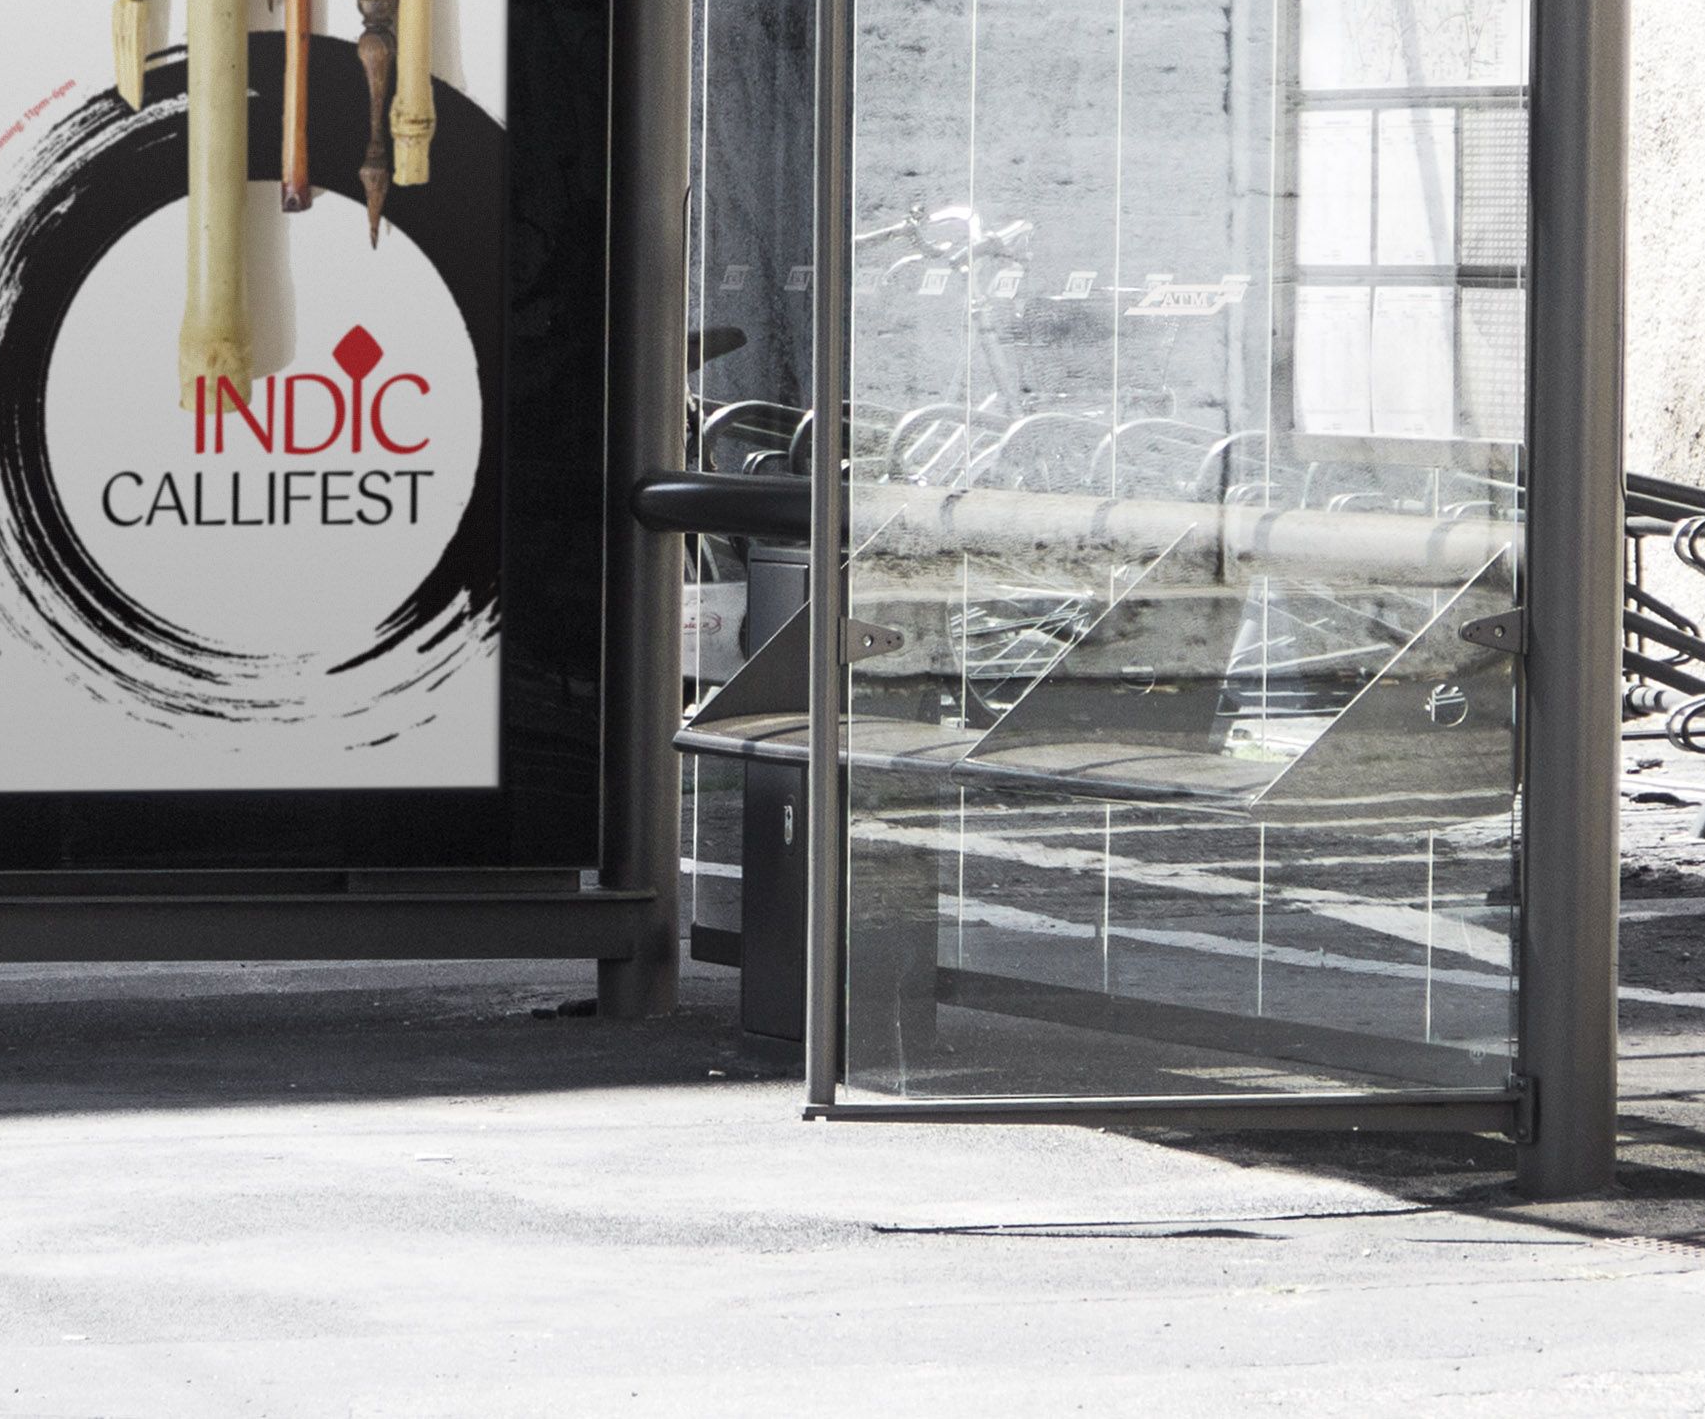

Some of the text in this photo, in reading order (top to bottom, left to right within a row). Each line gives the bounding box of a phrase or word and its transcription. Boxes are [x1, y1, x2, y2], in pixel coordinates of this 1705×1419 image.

[1160, 292, 1209, 307] ATM
[195, 324, 431, 455] INDIC
[101, 469, 435, 528] CALLIFEST
